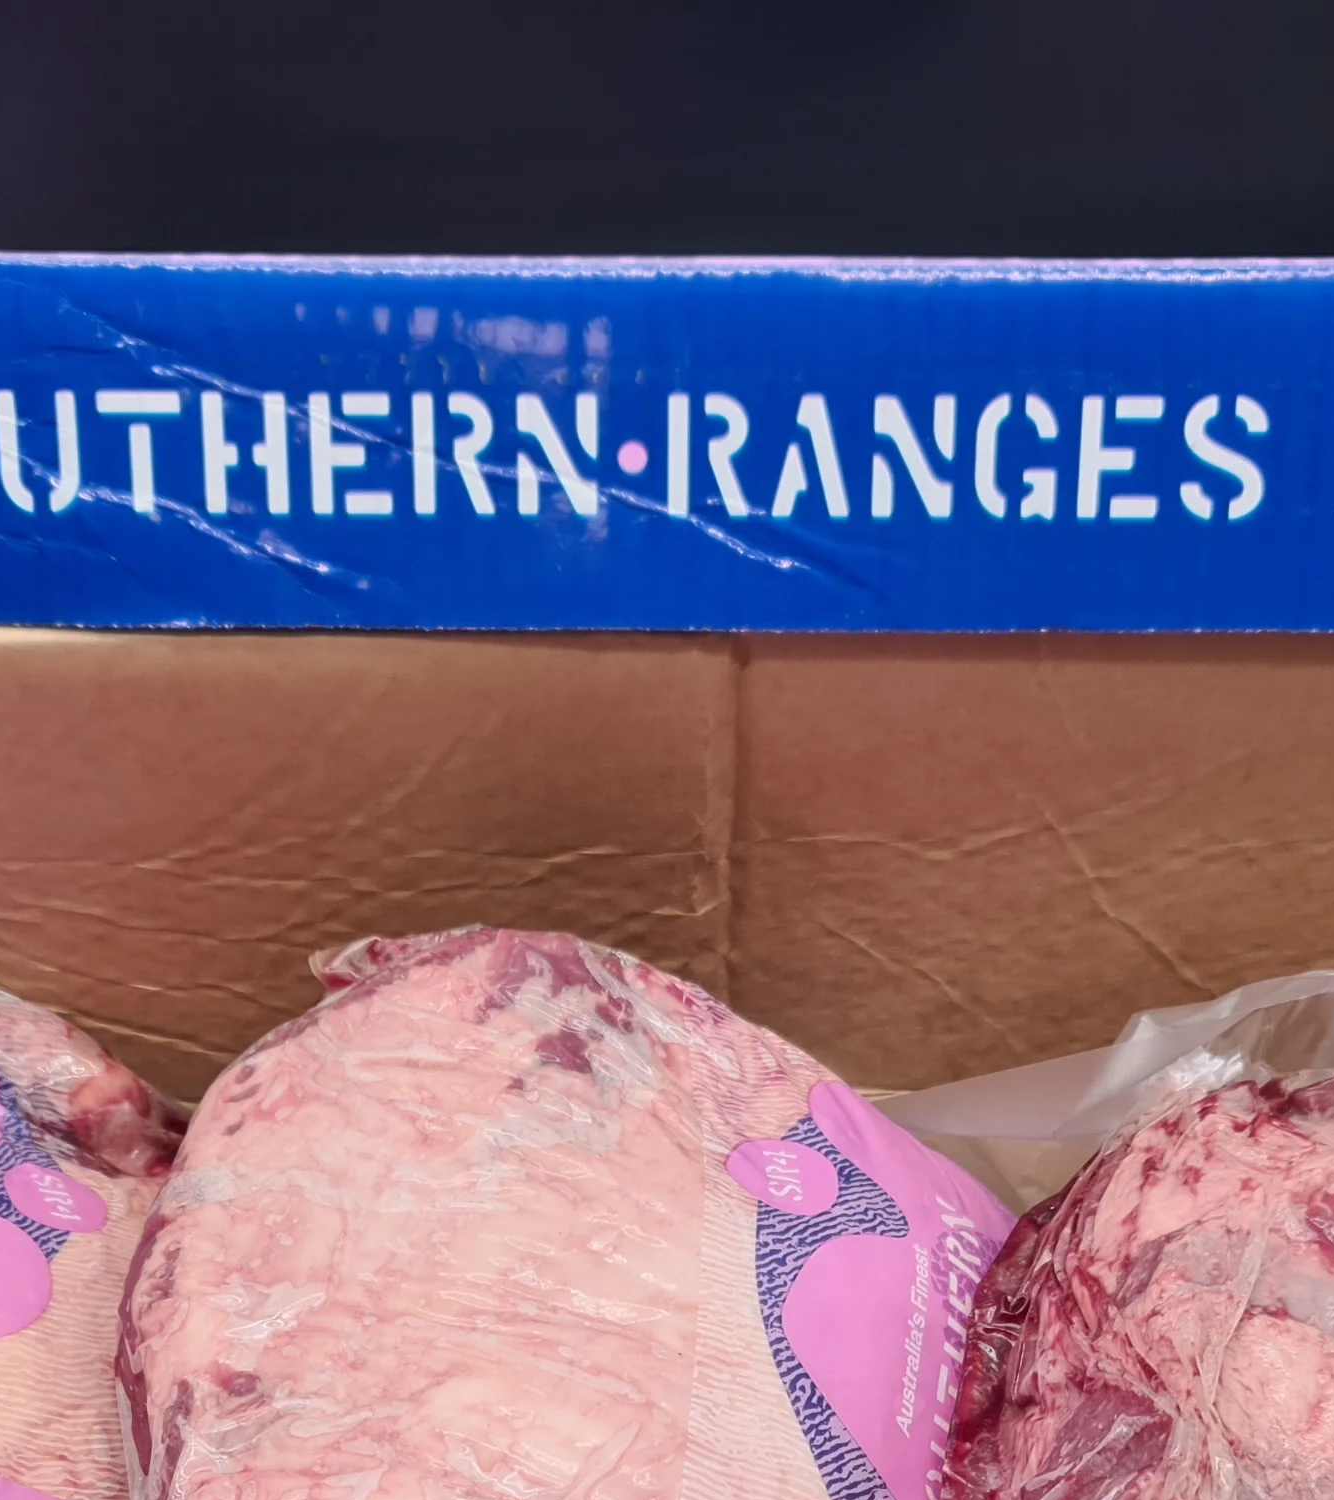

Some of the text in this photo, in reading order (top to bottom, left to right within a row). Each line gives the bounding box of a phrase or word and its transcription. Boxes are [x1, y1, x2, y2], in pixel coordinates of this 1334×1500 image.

[665, 391, 1271, 522] RANGES
[29, 1170, 83, 1222] SR4
[762, 1149, 804, 1202] SR4
[894, 1243, 930, 1439] Australia's Finest
